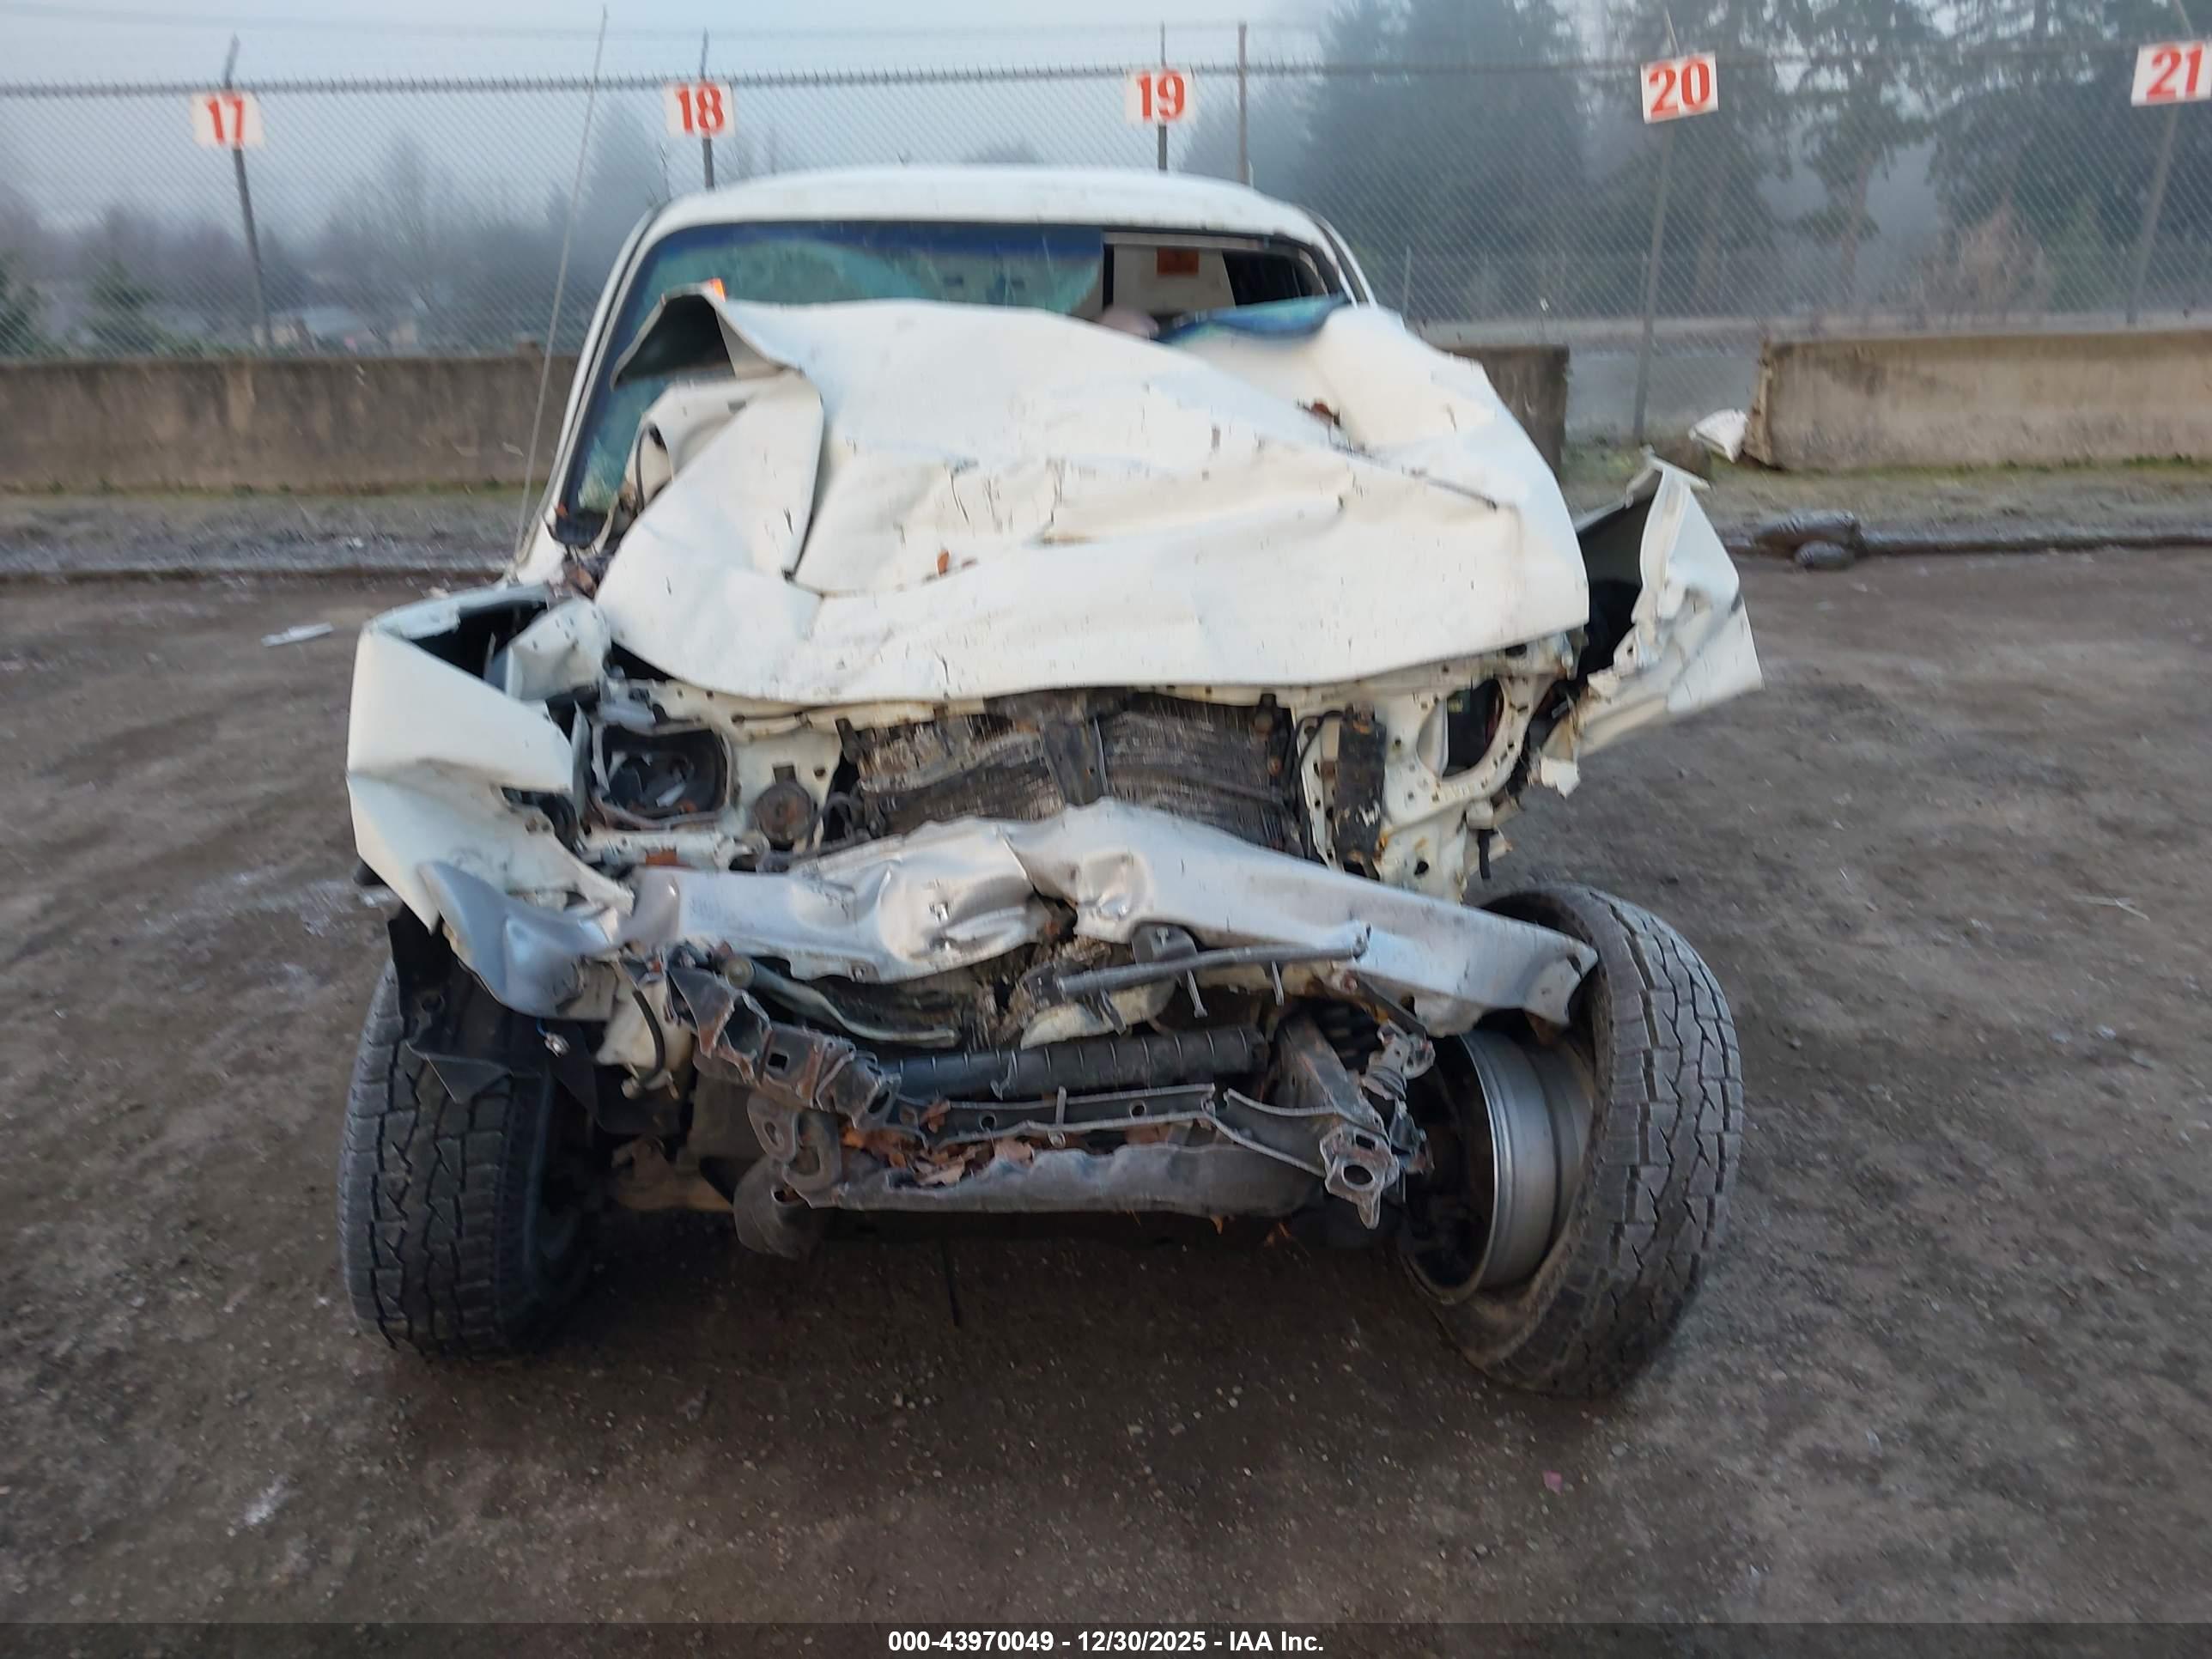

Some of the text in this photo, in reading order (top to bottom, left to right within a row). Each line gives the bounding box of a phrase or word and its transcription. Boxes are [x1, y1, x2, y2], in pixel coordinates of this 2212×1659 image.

[1136, 70, 1185, 120] 19
[1646, 57, 1711, 118] 20
[2146, 42, 2203, 101] 21
[204, 94, 246, 144] 17
[676, 82, 726, 136] 18
